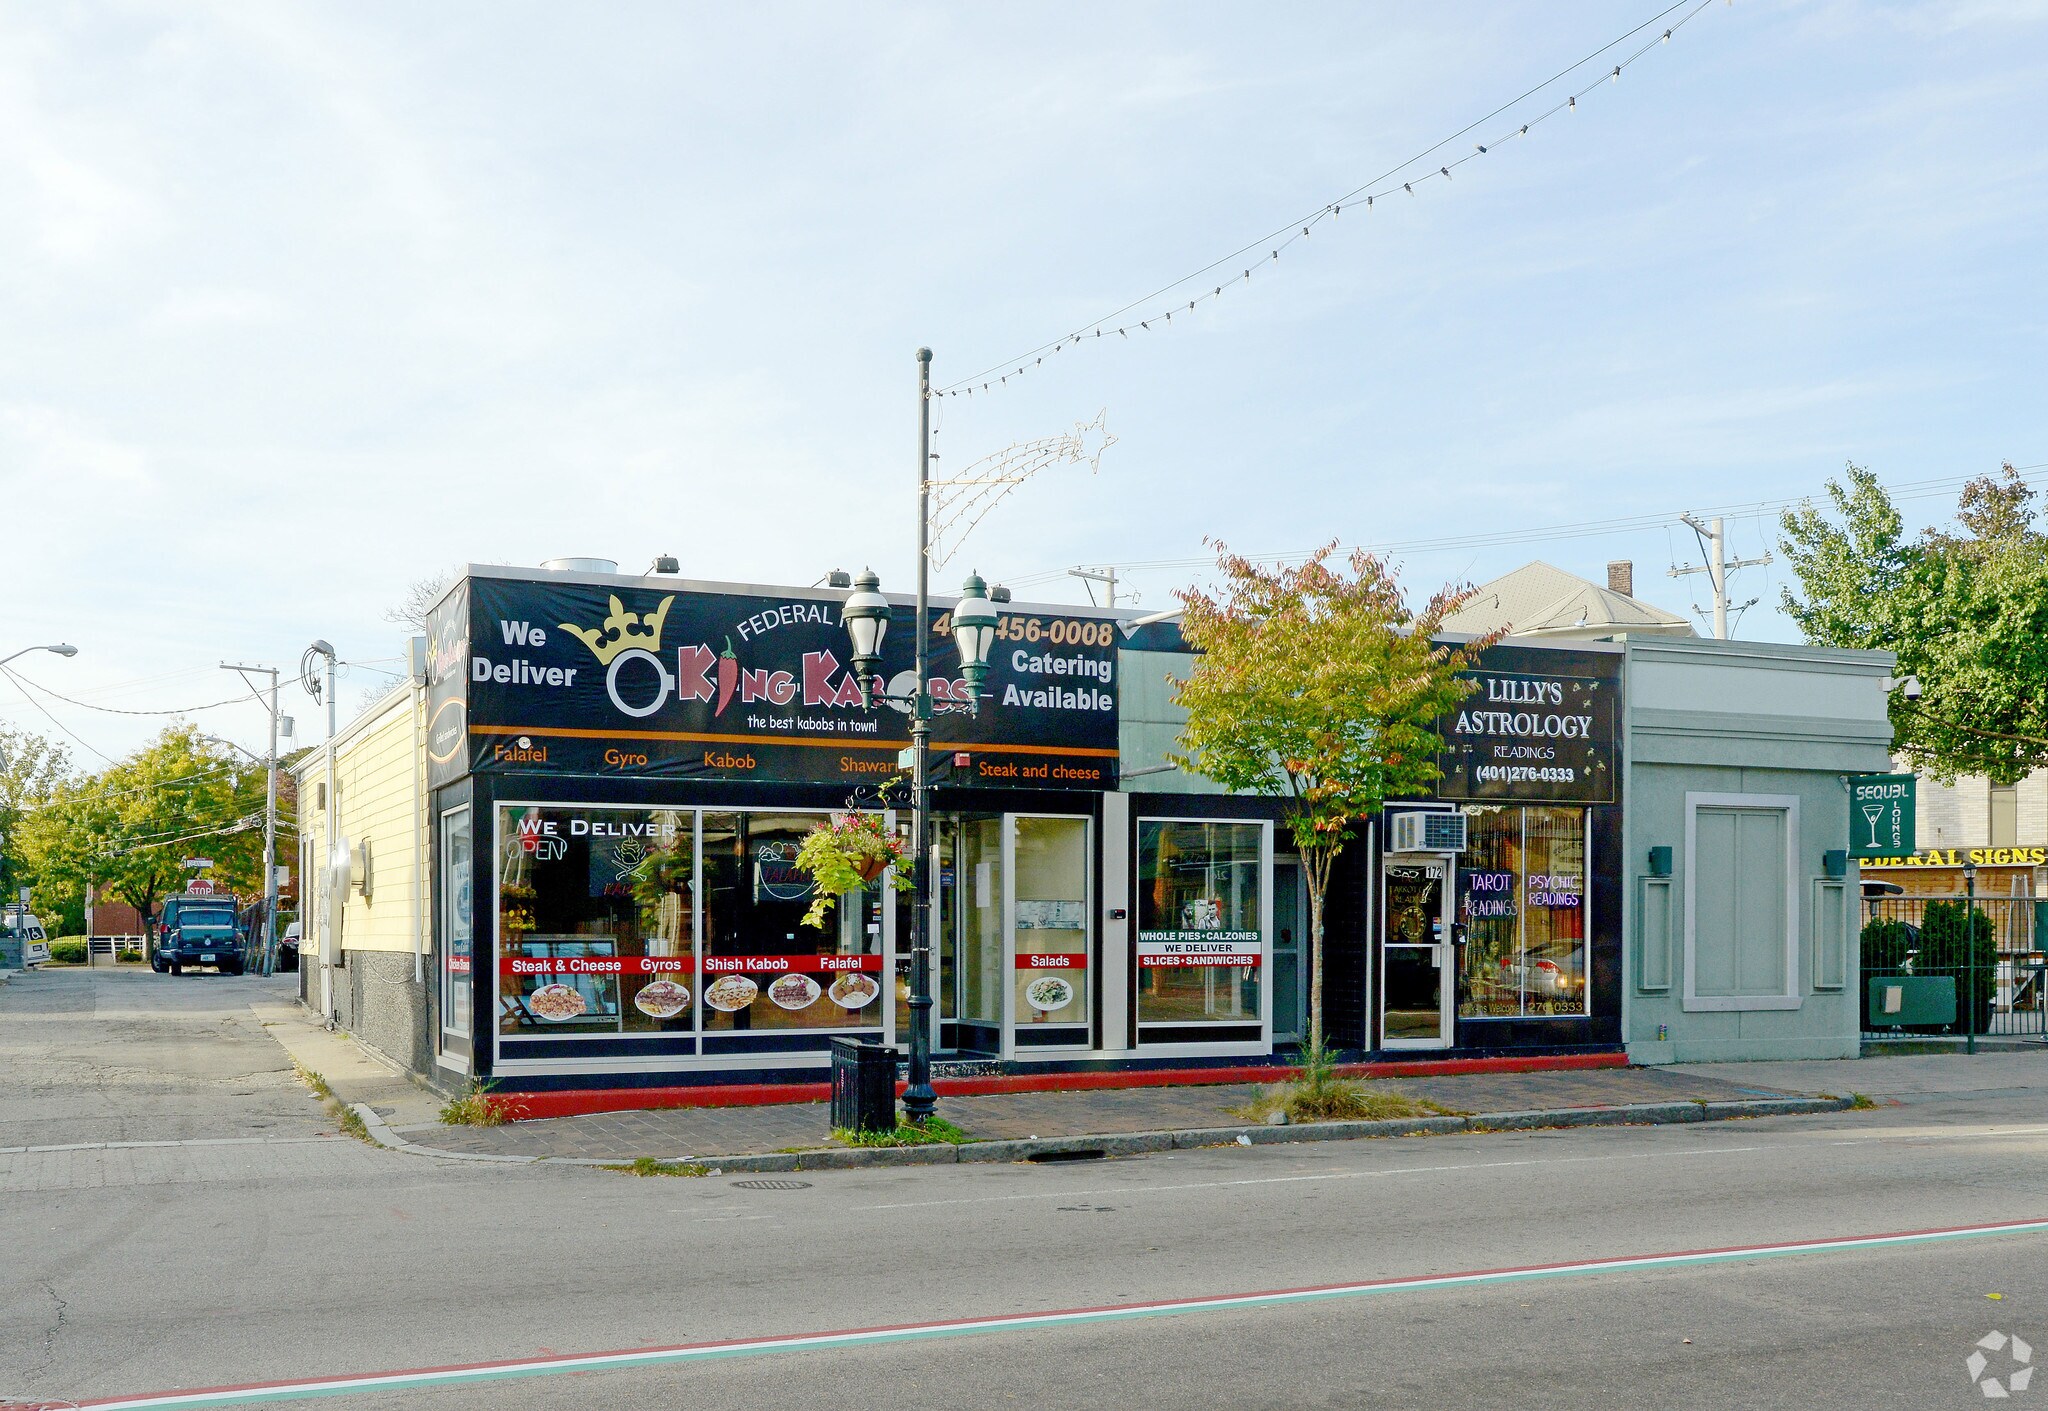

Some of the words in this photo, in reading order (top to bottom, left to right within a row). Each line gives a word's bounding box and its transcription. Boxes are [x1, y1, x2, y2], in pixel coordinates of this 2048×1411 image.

[737, 604, 833, 641] FEDERAL
[932, 612, 1113, 648] 4456-0008
[500, 620, 546, 647] We
[472, 657, 577, 687] Deliver
[1012, 650, 1112, 683] Catering
[1002, 684, 1113, 711] Available
[1487, 679, 1562, 705] LILLY'S
[748, 714, 766, 729] the
[769, 715, 793, 729] best
[797, 716, 834, 731] kabobs
[838, 719, 847, 731] in
[850, 719, 877, 733] town!
[1455, 710, 1593, 739] ASTROLOGY
[494, 745, 547, 762] Falafel
[604, 749, 647, 768] Gyro
[704, 751, 756, 769] Kabob
[1494, 746, 1555, 759] READINGS
[840, 756, 910, 774] Shawar
[979, 762, 1018, 777] Steak
[1023, 763, 1048, 778] and
[1053, 765, 1100, 779] cheese
[1476, 766, 1575, 784] (401)276-0333
[506, 840, 563, 860] OPEN
[1969, 847, 2045, 865] SIGNS
[1426, 866, 1442, 878] 172
[1469, 874, 1511, 892] TAROT
[1528, 875, 1579, 889] PSYCHIC
[189, 887, 211, 895] STOP
[1528, 892, 1579, 906] READINGS
[1466, 899, 1518, 916] READINGS
[1140, 932, 1175, 940] WHOLE
[1206, 931, 1257, 940] CALZONES
[1165, 944, 1182, 953] WE
[1186, 944, 1232, 952] DELIVER
[512, 960, 551, 972] Steak
[555, 960, 566, 972] &
[570, 959, 621, 972] Cheese
[640, 958, 682, 973] Gyros
[705, 957, 743, 970] Shish
[747, 957, 788, 970] Kabob
[820, 957, 862, 969] Falafel
[1031, 955, 1070, 967] Salads
[1143, 957, 1179, 965] SLICES
[1186, 955, 1253, 965] SANDWICHES
